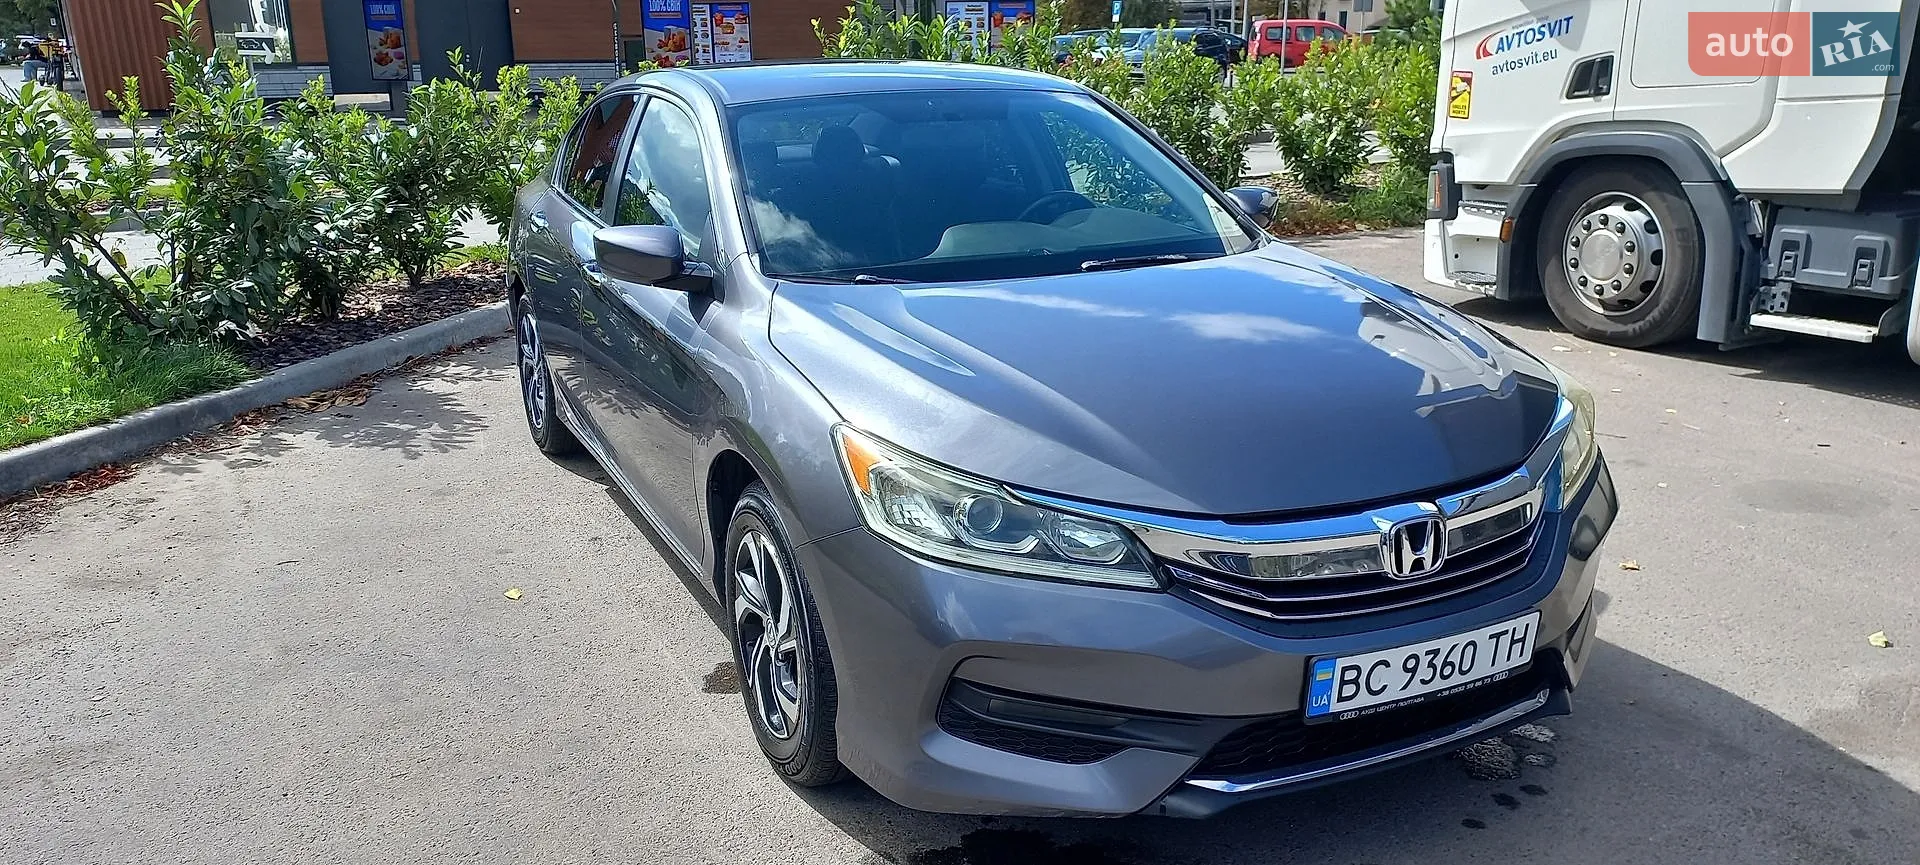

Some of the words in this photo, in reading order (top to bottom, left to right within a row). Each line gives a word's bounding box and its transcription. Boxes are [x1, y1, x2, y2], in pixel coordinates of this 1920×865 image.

[1495, 15, 1574, 55] AVTOSVIT
[1491, 48, 1558, 76] avtosvit.eu
[1336, 659, 1391, 704] BC
[1399, 639, 1478, 692] 9360
[1488, 623, 1530, 667] TH
[1312, 694, 1329, 708] UA
